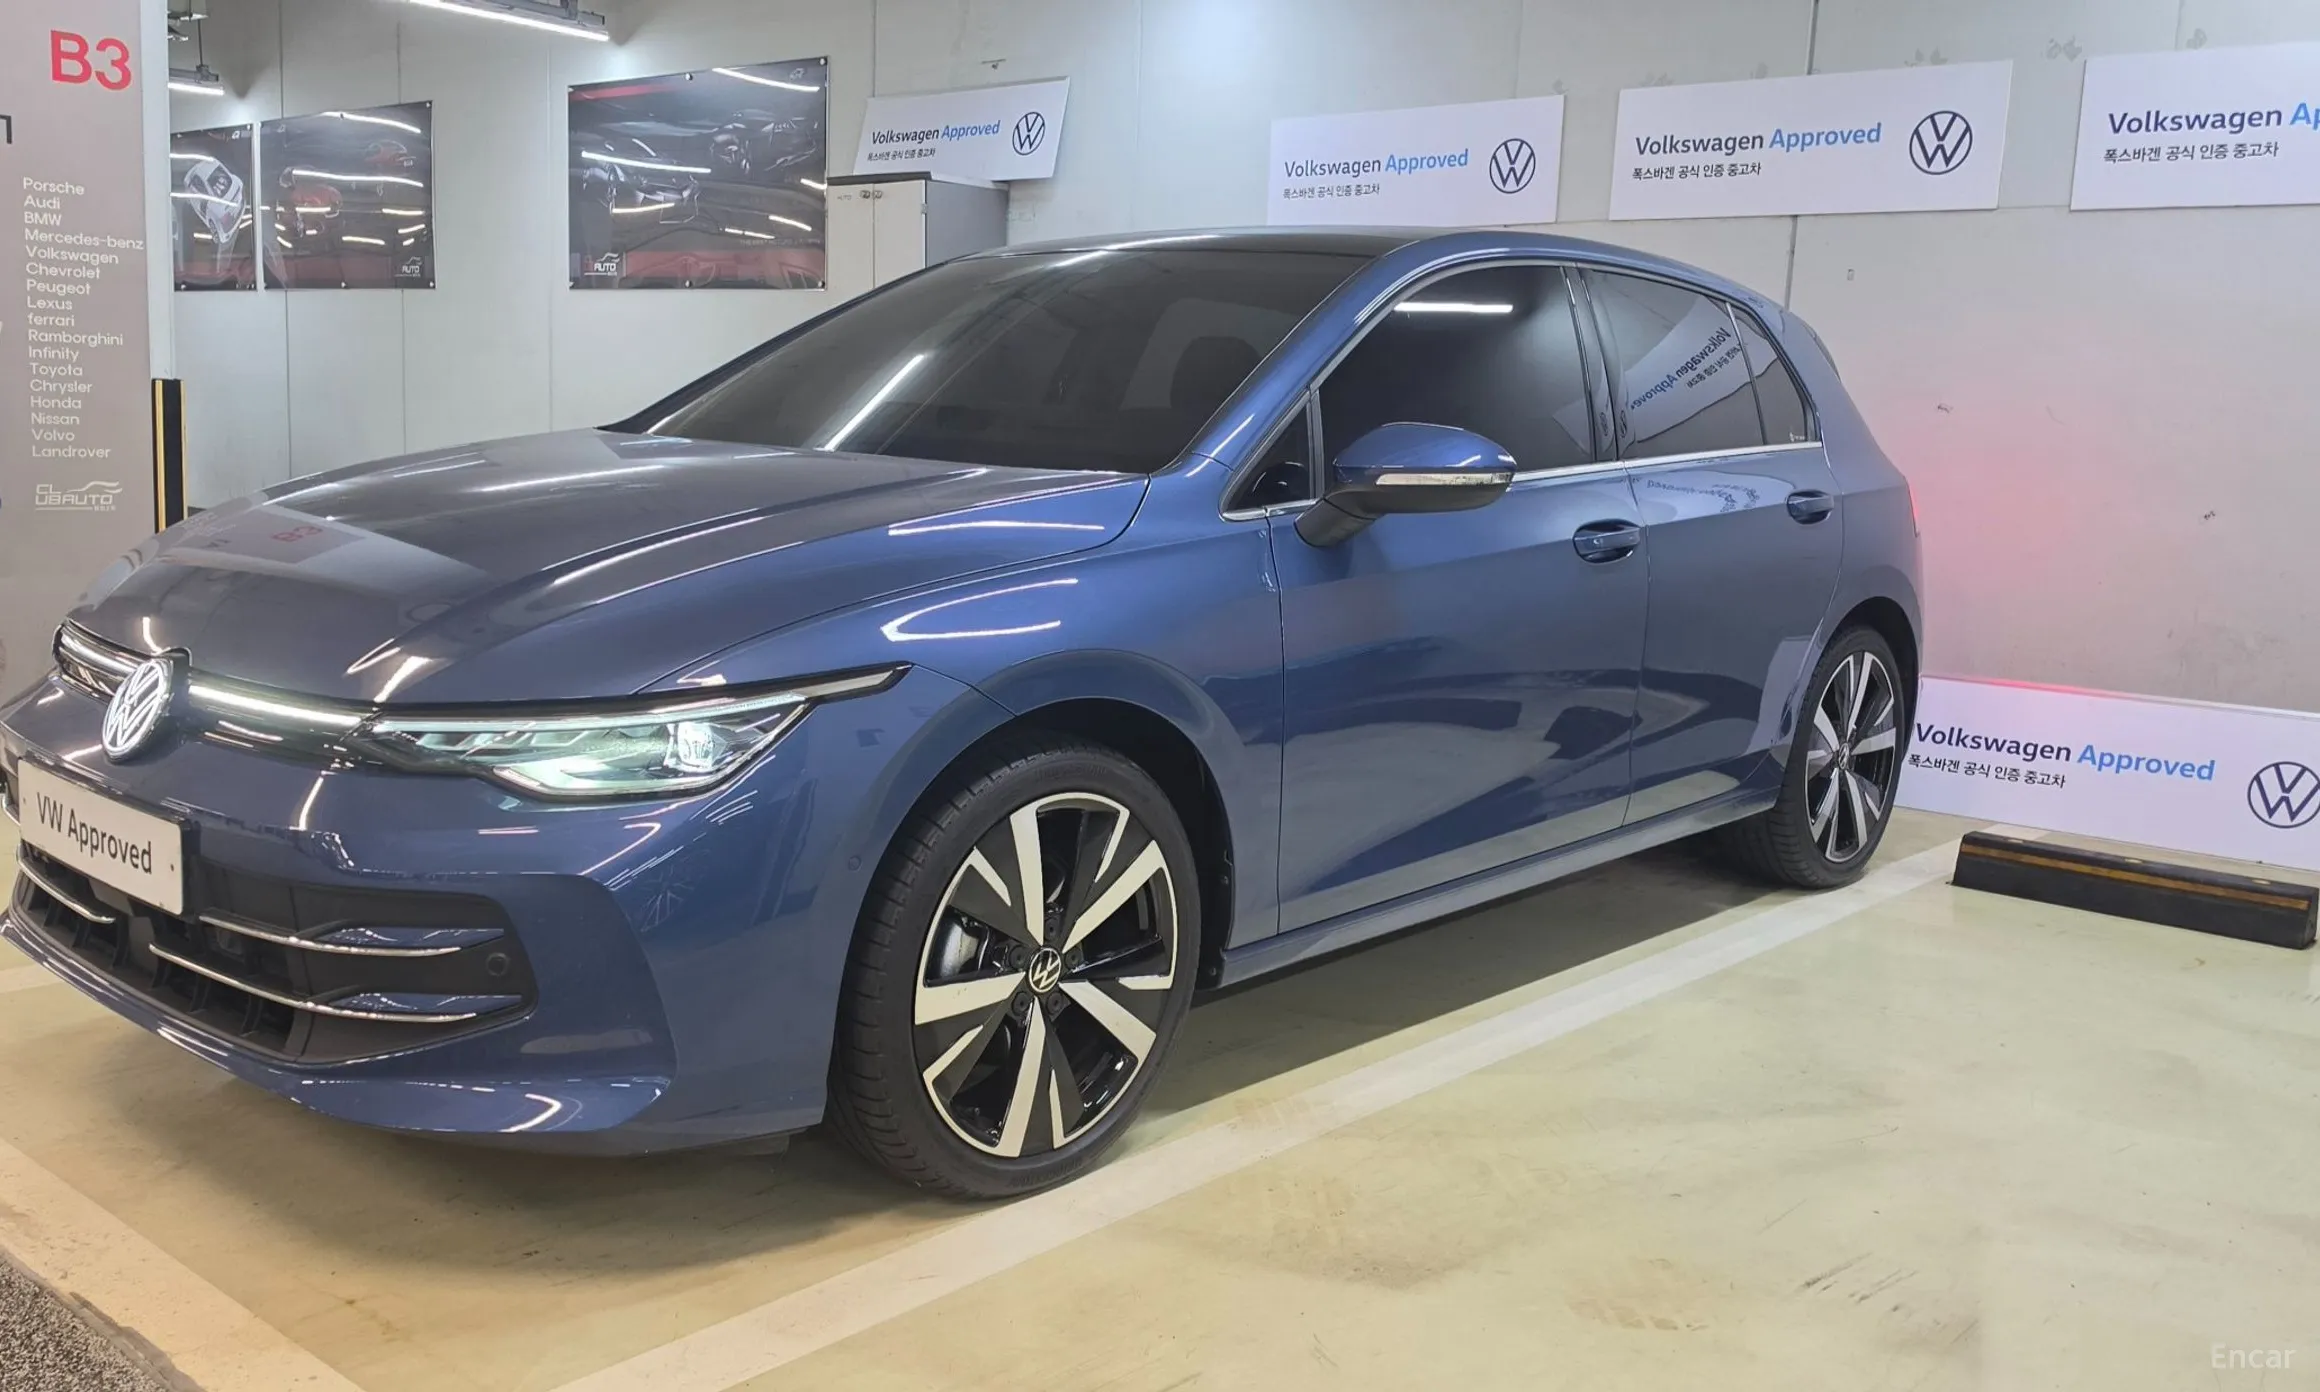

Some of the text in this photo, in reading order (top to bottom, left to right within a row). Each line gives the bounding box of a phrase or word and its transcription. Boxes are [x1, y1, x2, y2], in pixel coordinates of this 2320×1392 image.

[50, 30, 132, 90] B3
[2108, 109, 2282, 135] Volkswagen
[872, 120, 1001, 146] Volkswagen Approved
[1635, 122, 1882, 156] Volkswagen Approved
[2104, 141, 2279, 164] 폭스바겐 공식 인증 중고차
[1284, 148, 1469, 178] Volkswagen Approved
[1632, 162, 1762, 182] 폭스바겐 공식 인증 중고차
[23, 177, 84, 195] Porsche
[1354, 183, 1380, 197] 중고차
[24, 196, 61, 210] Audi
[24, 211, 62, 226] BMW
[25, 228, 144, 250] Mercedes-benz
[26, 246, 119, 266] Volkswagen
[26, 263, 100, 279] Chevrolet
[593, 262, 616, 272] AUTO
[27, 279, 91, 296] Peugeot
[27, 296, 73, 310] Lexus
[28, 313, 75, 327] ferrari
[28, 329, 123, 347] Ramborghini
[29, 346, 79, 362] Infinity
[29, 362, 83, 377] Toyota
[30, 379, 93, 394] Chrysler
[30, 396, 82, 409] Honda
[31, 412, 80, 425] Nissan
[31, 428, 75, 442] Volvo
[32, 445, 111, 459] Landrover
[1916, 722, 2217, 781] Volkswagen Approved
[1907, 753, 2066, 789] 폭스바겐 공식 인증 중고차
[37, 792, 153, 875] VW Approved
